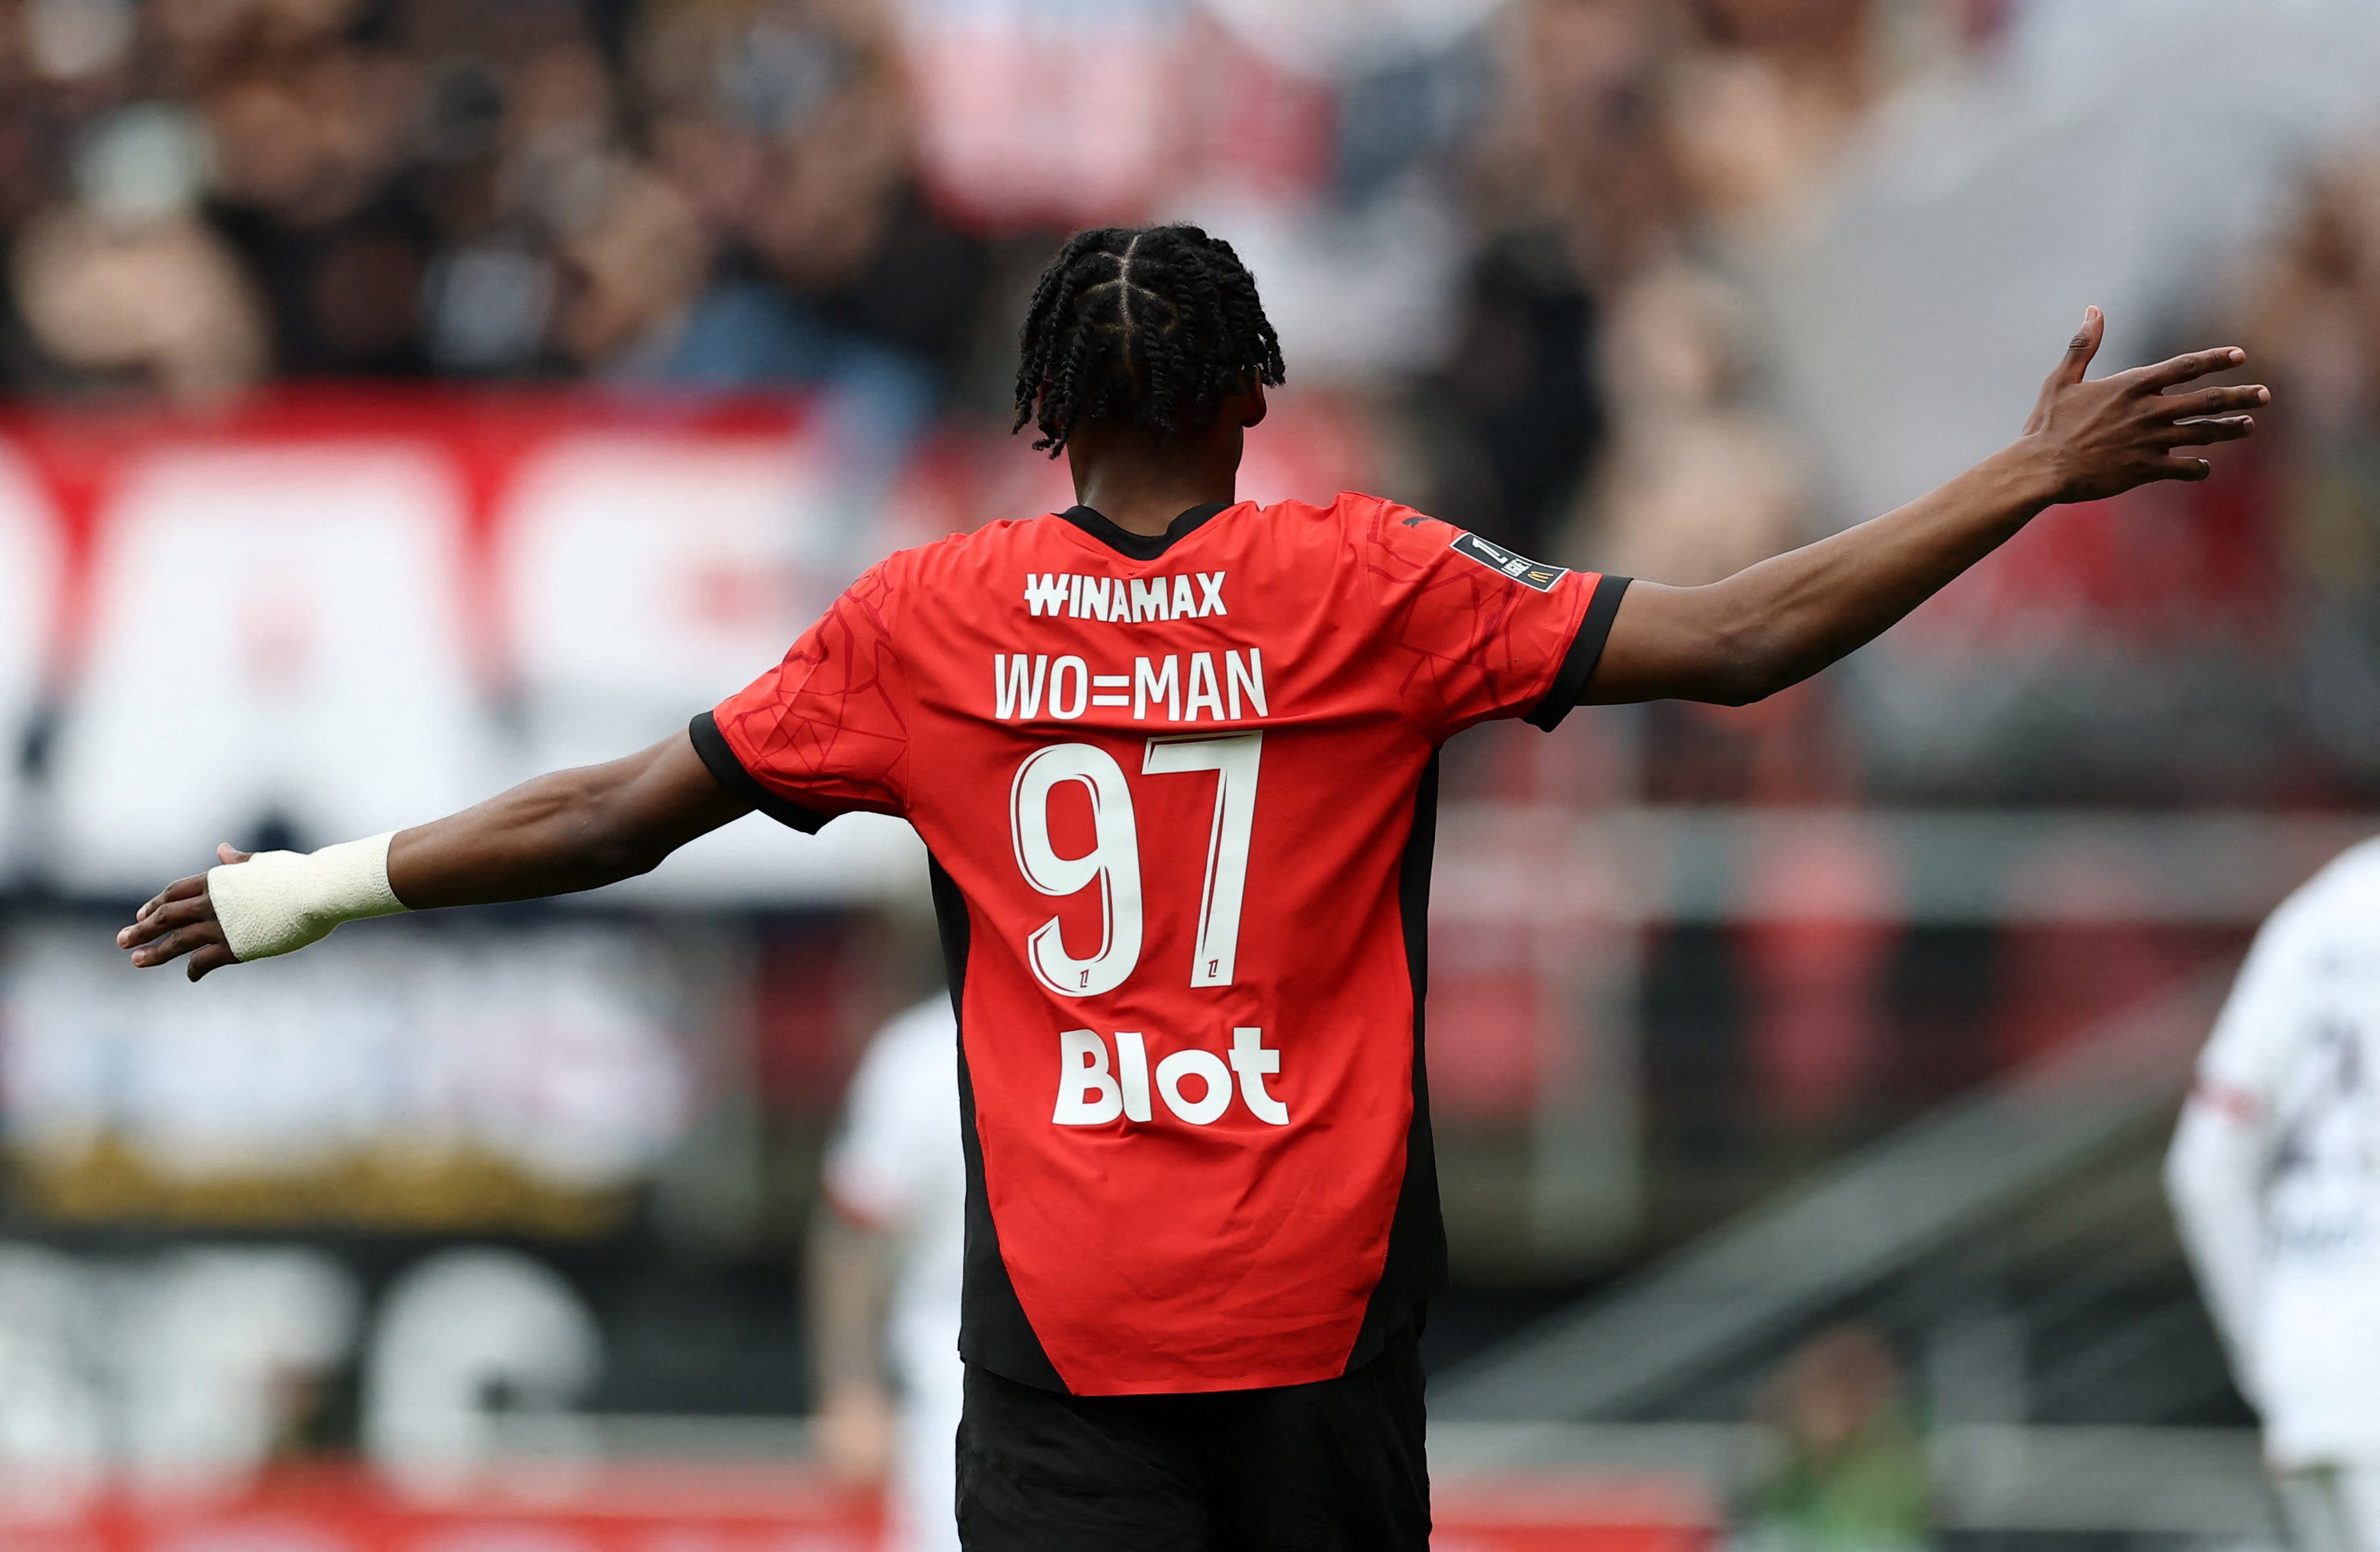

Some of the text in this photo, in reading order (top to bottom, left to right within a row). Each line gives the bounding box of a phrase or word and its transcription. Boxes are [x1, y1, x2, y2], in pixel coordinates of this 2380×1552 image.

[1024, 571, 1228, 623] WINAMAX
[994, 647, 1269, 722] WO=MAN
[1009, 729, 1264, 998] 97
[1051, 1027, 1290, 1126] Blot
